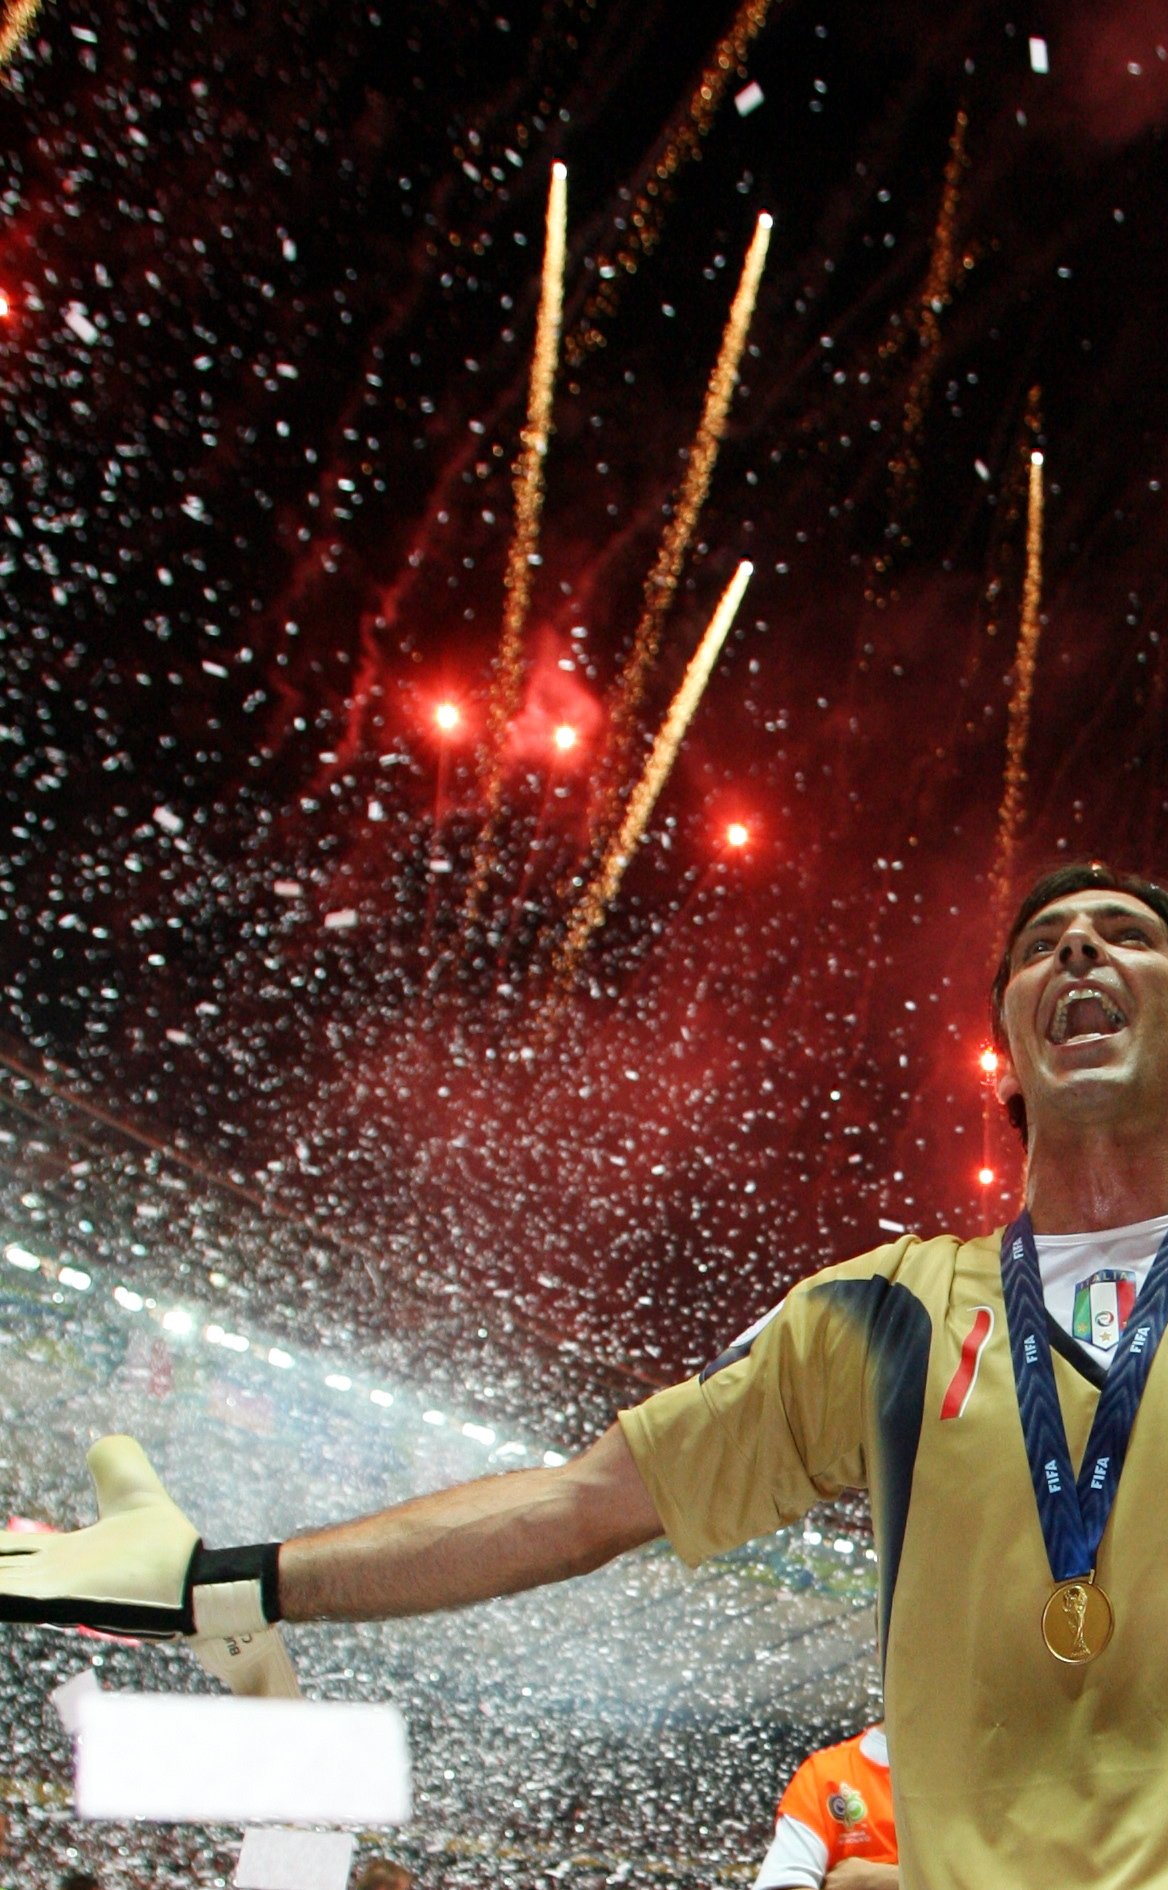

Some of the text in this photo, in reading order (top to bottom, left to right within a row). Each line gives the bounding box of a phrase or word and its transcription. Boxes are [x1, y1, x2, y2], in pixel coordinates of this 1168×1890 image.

[1012, 1236, 1024, 1260] FIFA
[1024, 1334, 1038, 1364] FIFA
[1130, 1326, 1151, 1353] FIFA
[939, 1305, 995, 1421] 1
[1044, 1459, 1062, 1494] FIFA
[1090, 1456, 1110, 1490] FIFA
